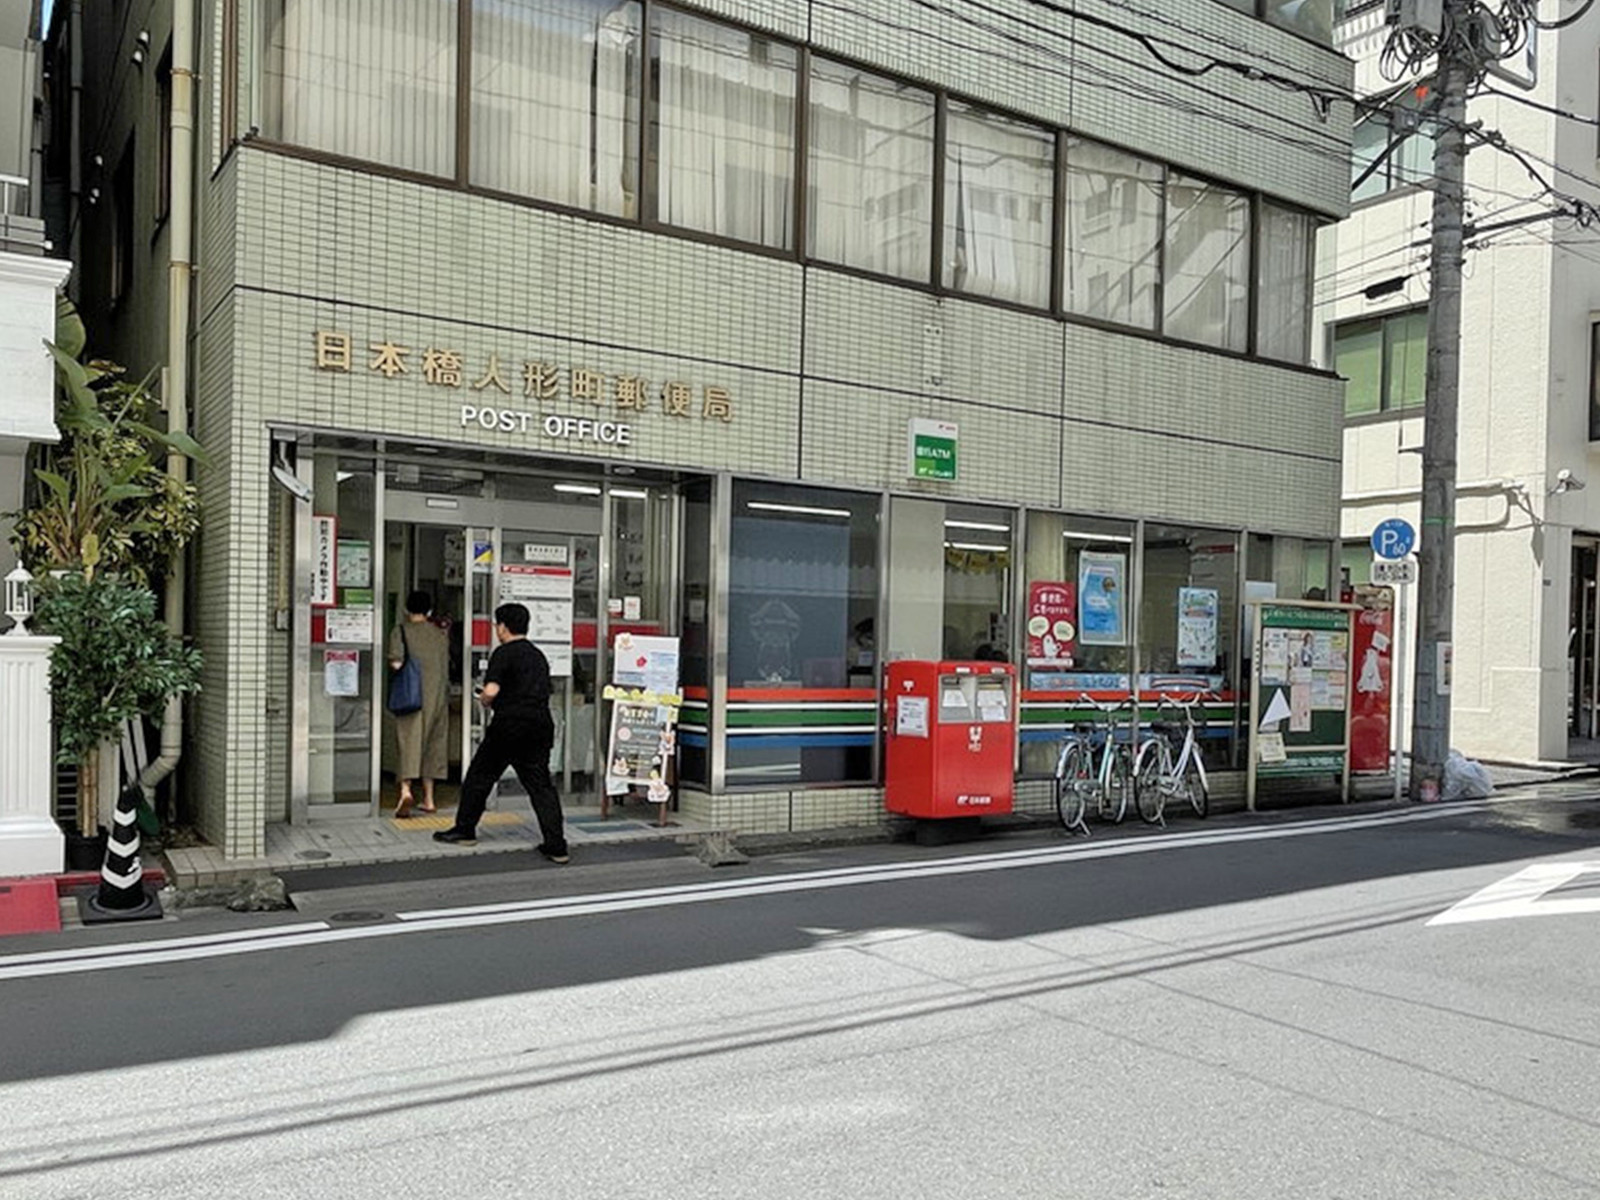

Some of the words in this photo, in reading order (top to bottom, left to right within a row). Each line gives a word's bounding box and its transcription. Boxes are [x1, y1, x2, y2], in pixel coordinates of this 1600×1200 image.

[314, 330, 734, 422] 日本橋人形町郵便局
[461, 405, 531, 433] POST
[544, 416, 631, 446] OFFICE
[1382, 530, 1398, 555] P
[1393, 542, 1406, 555] 60
